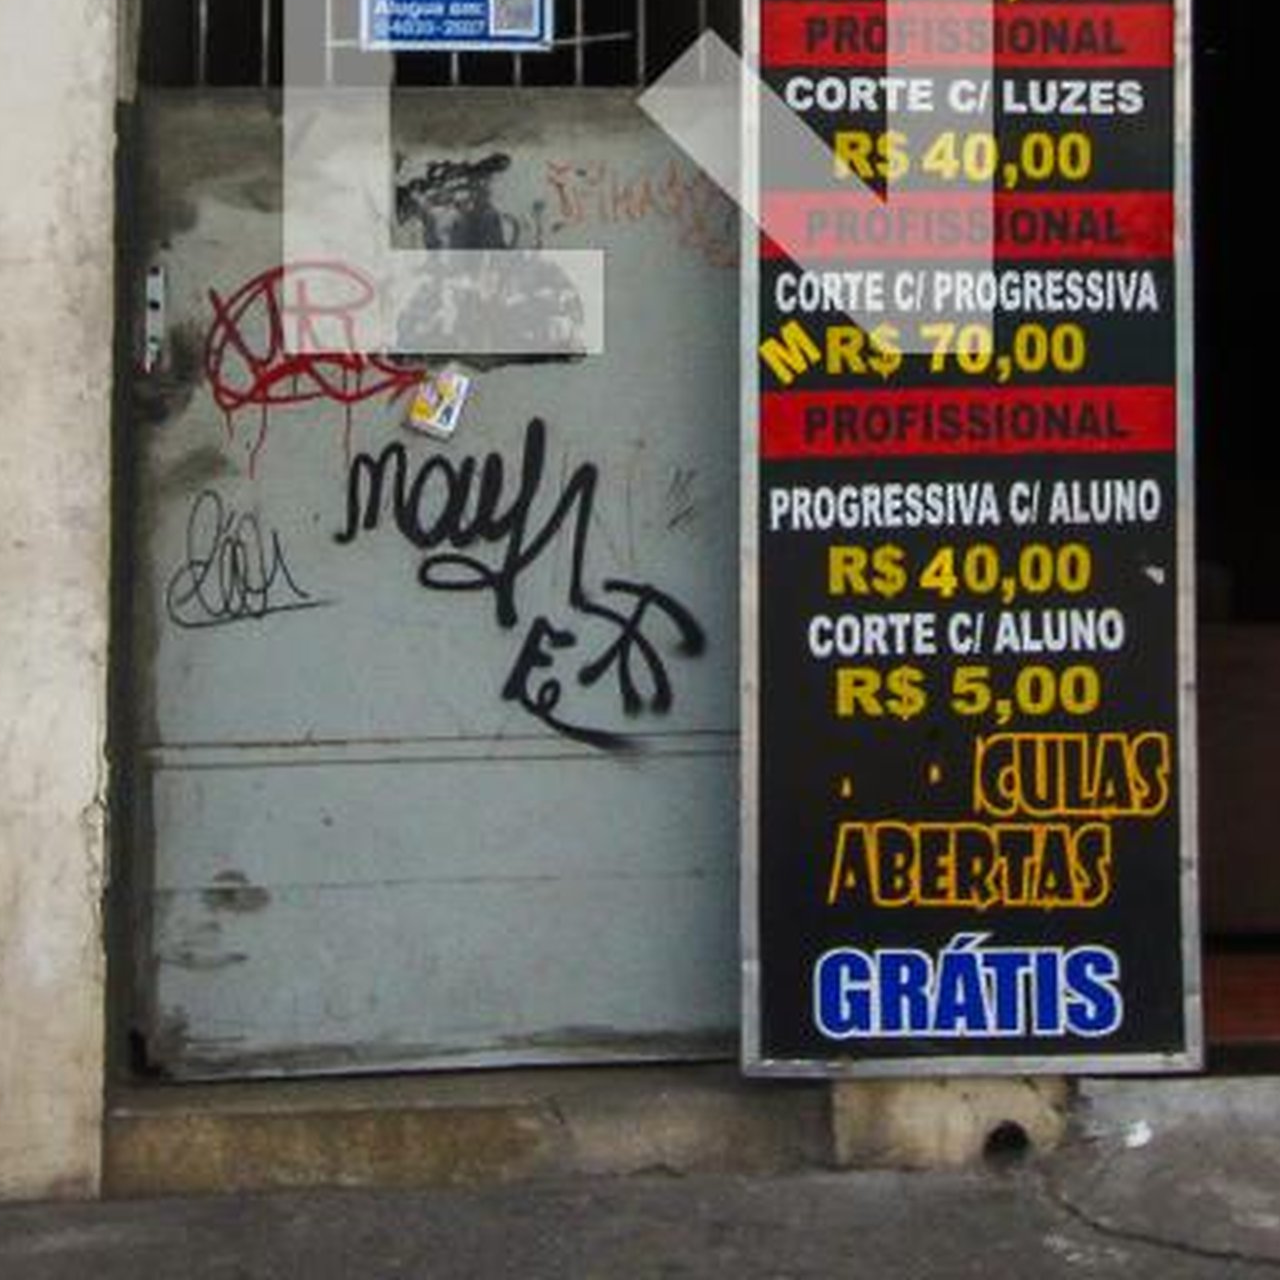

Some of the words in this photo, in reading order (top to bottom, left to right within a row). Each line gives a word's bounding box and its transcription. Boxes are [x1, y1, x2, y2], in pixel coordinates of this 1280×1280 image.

[803, 17, 1126, 55] PROFISSIONAL
[784, 77, 934, 113] CORTE
[947, 79, 991, 113] C/
[1002, 79, 1145, 115] LUZES
[832, 130, 909, 182] R$
[922, 130, 1092, 189] 40,00
[806, 206, 1127, 246] PROFISSIONAL
[774, 271, 885, 313] CORTE
[893, 272, 926, 313] C/
[933, 270, 1161, 313] PROGRESSIVA
[824, 322, 904, 380] R$
[920, 322, 1087, 383] 70,00
[803, 403, 1128, 446] PROFISSIONAL
[769, 481, 1001, 531] PROGRESSIVA
[1008, 481, 1041, 524] C/
[1048, 479, 1162, 523] ALUNO
[826, 544, 908, 599] R$
[919, 544, 1092, 605] 40,00
[808, 612, 938, 658] CORTE
[947, 614, 985, 655] C/
[993, 609, 1125, 654] ALUNO
[835, 665, 926, 720] R$
[949, 665, 1102, 725] 5,00
[827, 822, 1111, 910] ABERTAS
[813, 931, 1123, 1040] GRÁTIS
